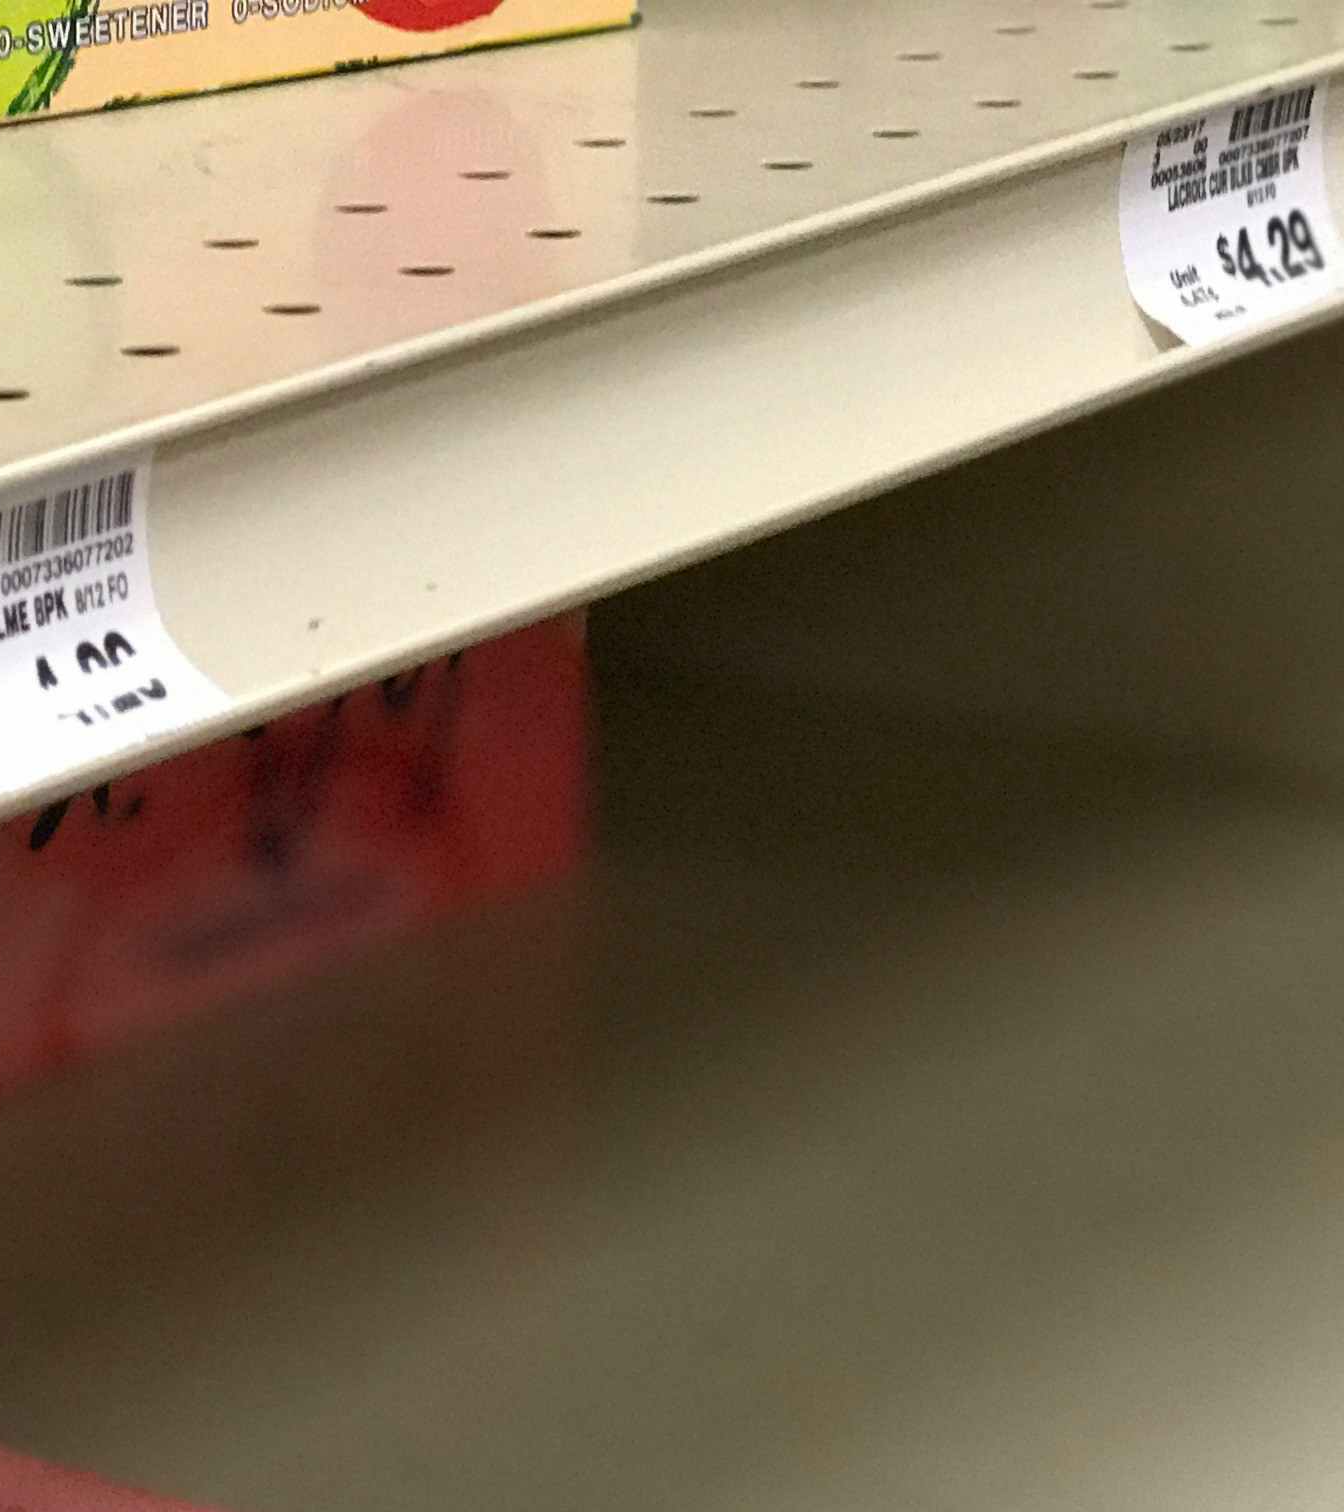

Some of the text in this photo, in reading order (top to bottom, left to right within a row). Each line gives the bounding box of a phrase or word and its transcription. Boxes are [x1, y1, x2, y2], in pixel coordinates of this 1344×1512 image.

[231, 0, 358, 24] 0-SOD
[1216, 207, 1325, 288] $4.29
[1169, 265, 1201, 290] Unit
